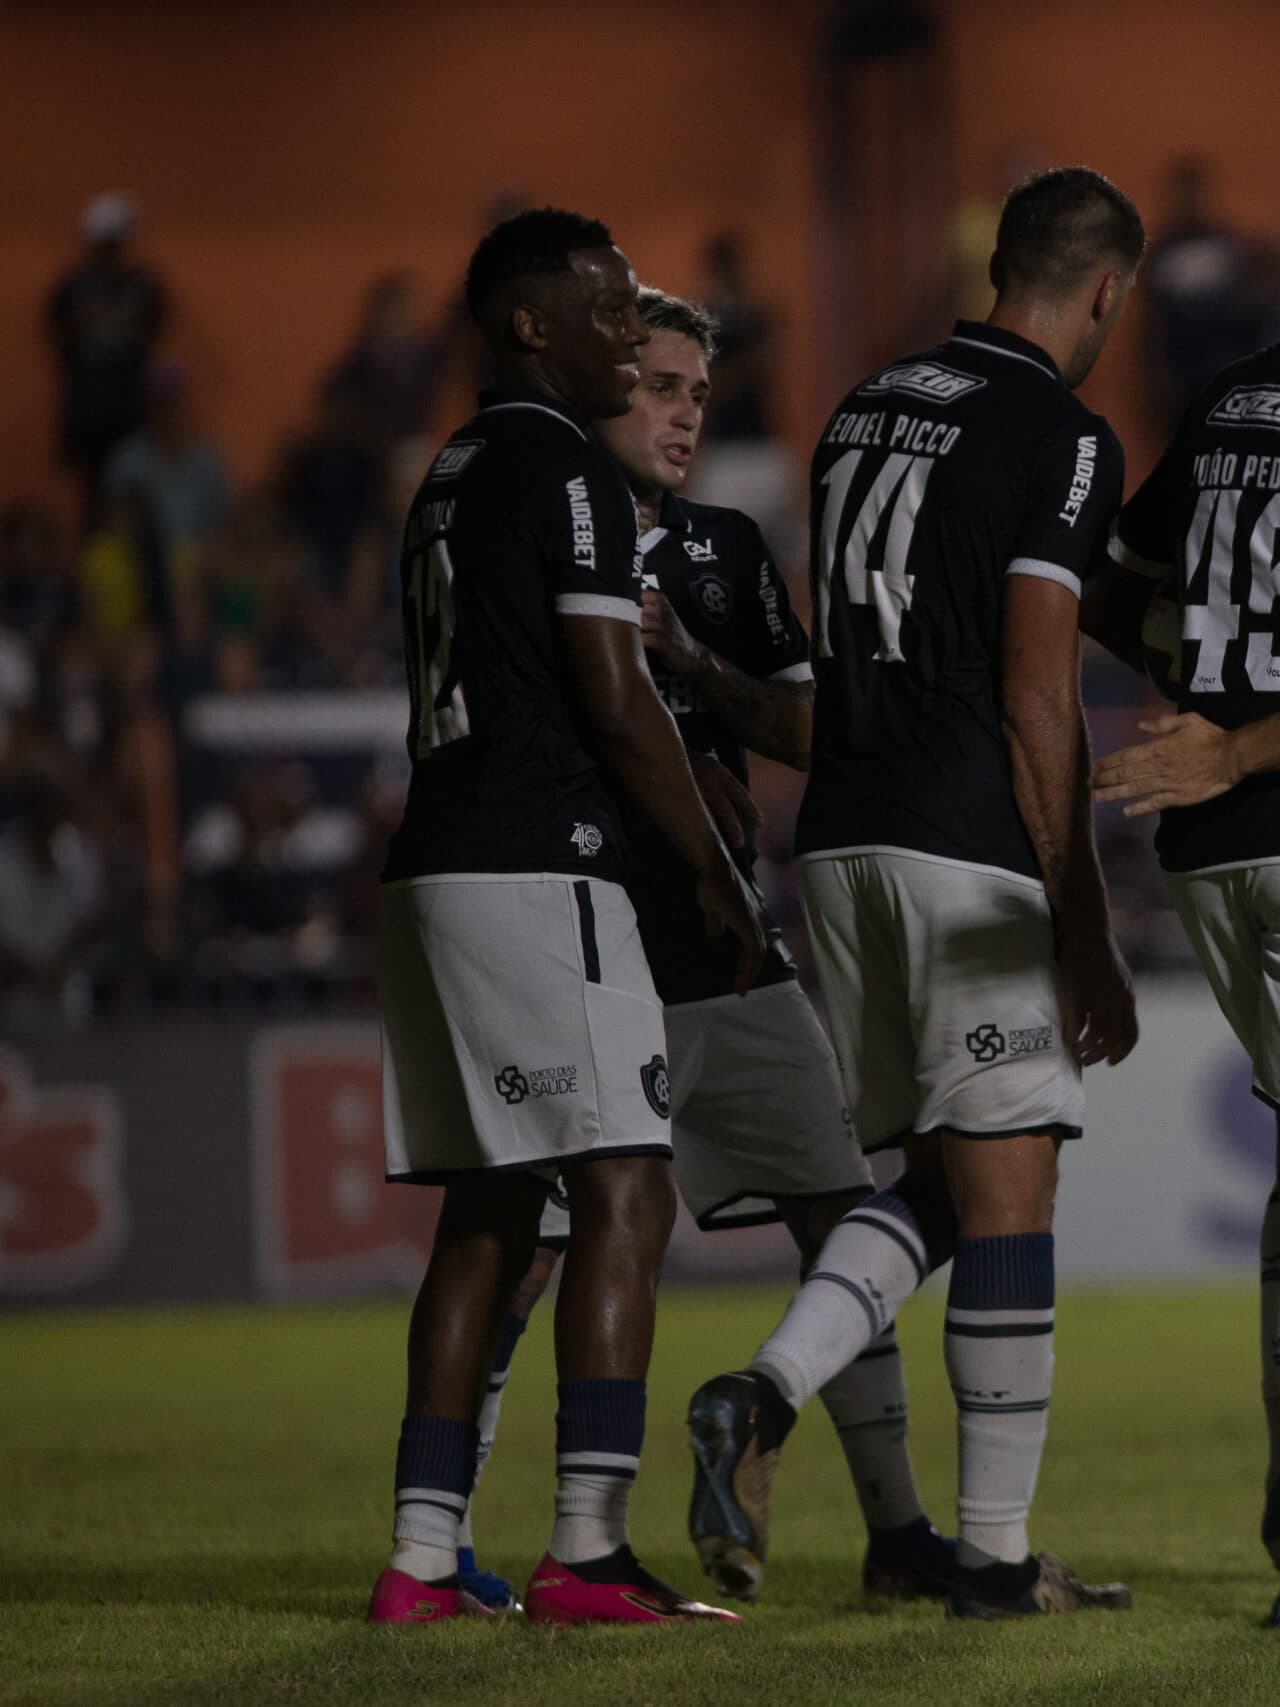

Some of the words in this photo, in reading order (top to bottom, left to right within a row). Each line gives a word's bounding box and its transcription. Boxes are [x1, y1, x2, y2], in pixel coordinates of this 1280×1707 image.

[824, 411, 887, 445] EONEL
[888, 413, 962, 456] PICCO
[565, 475, 596, 570] VAIDEBET
[1058, 435, 1097, 528] VAIDEBET
[819, 449, 935, 662] 14
[529, 1067, 555, 1080] PORTO
